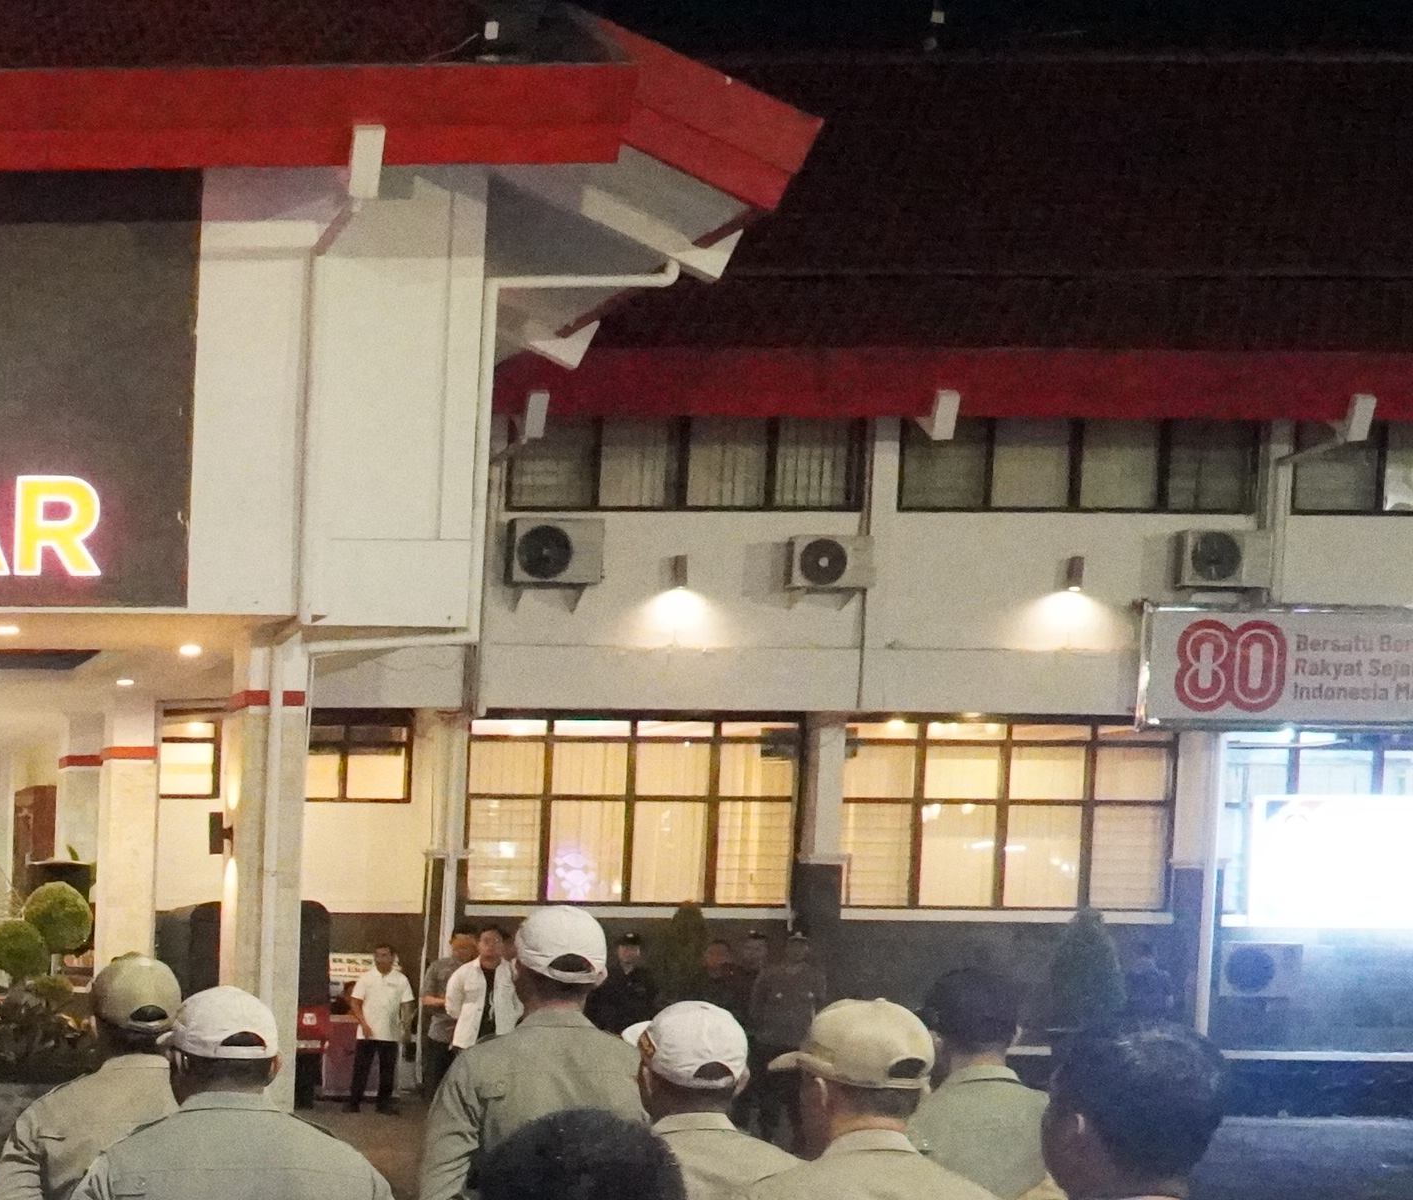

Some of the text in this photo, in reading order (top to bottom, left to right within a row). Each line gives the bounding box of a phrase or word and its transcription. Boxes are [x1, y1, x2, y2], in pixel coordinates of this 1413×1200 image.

[1296, 634, 1413, 652] Bersatu Ber
[1175, 618, 1287, 713] 80
[1294, 658, 1413, 681] Rakyat Seja
[1293, 682, 1413, 700] Indonesia M
